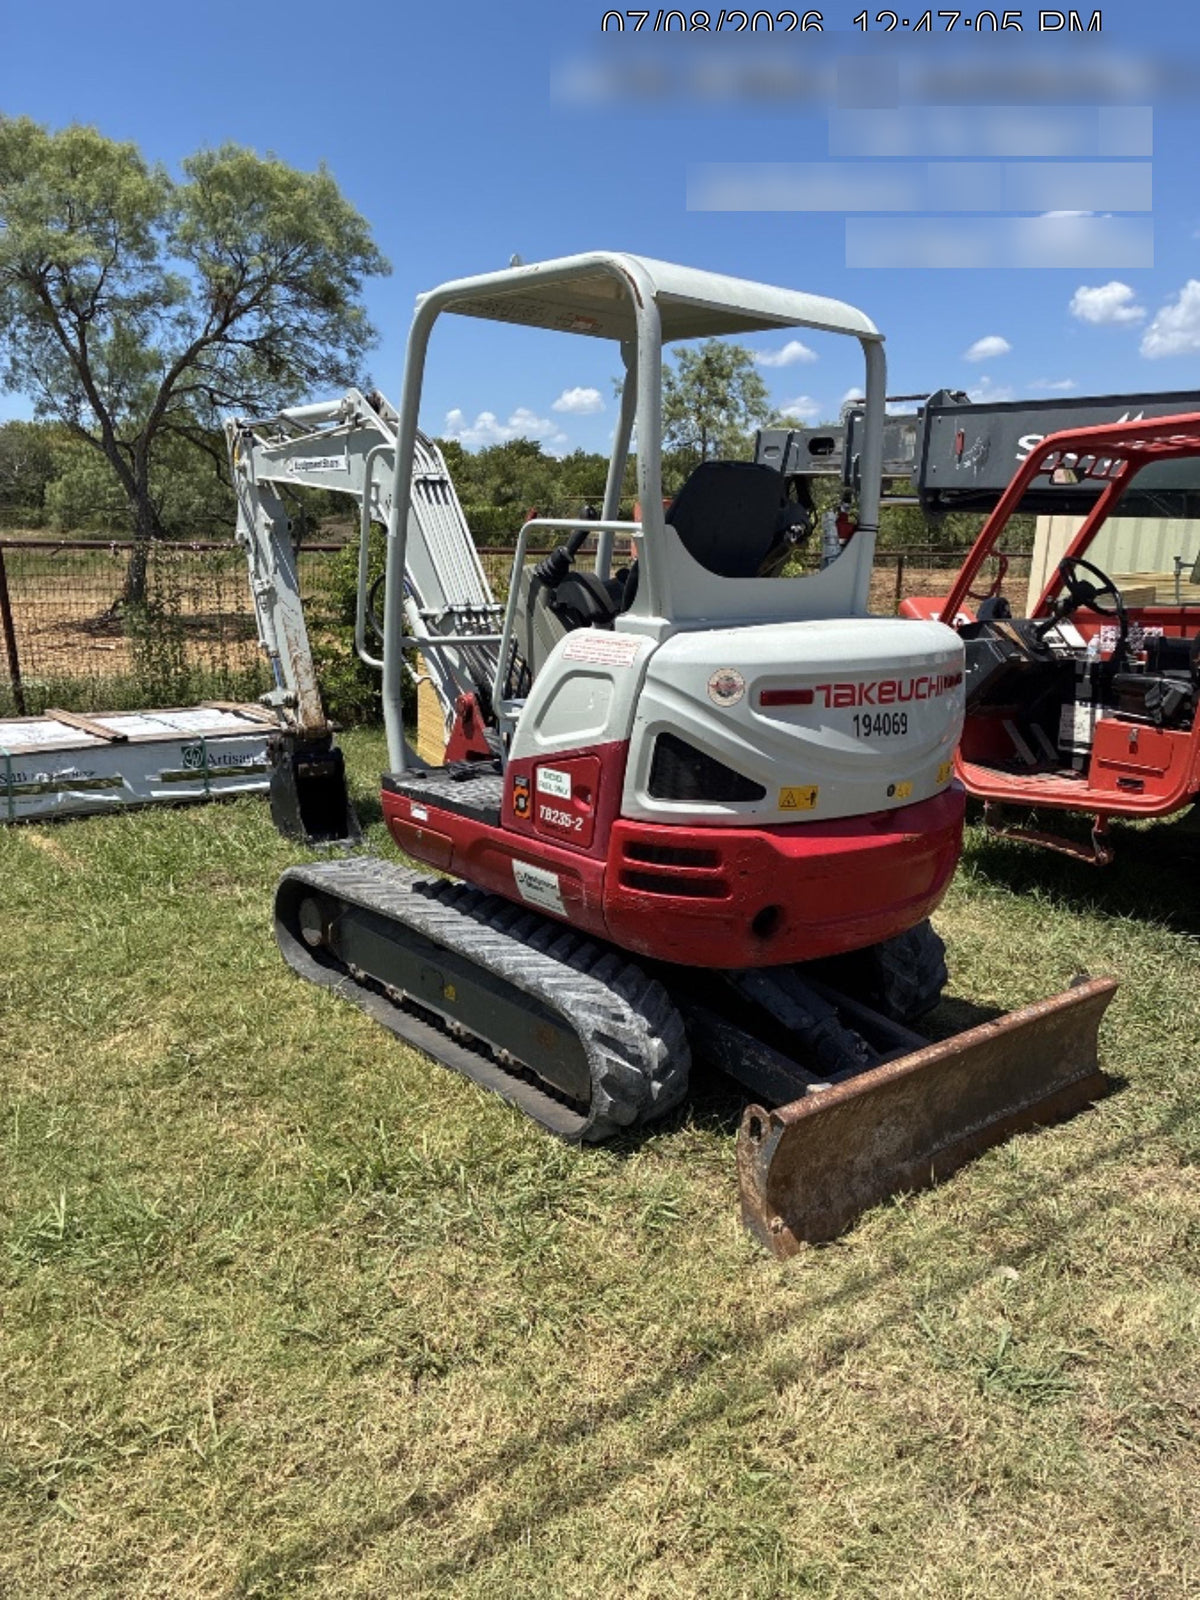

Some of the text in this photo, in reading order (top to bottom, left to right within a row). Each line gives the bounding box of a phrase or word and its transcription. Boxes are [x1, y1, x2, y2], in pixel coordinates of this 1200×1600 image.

[815, 675, 943, 708] TAKEUCHI
[853, 712, 908, 737] 194069
[539, 804, 584, 831] TB235-2
